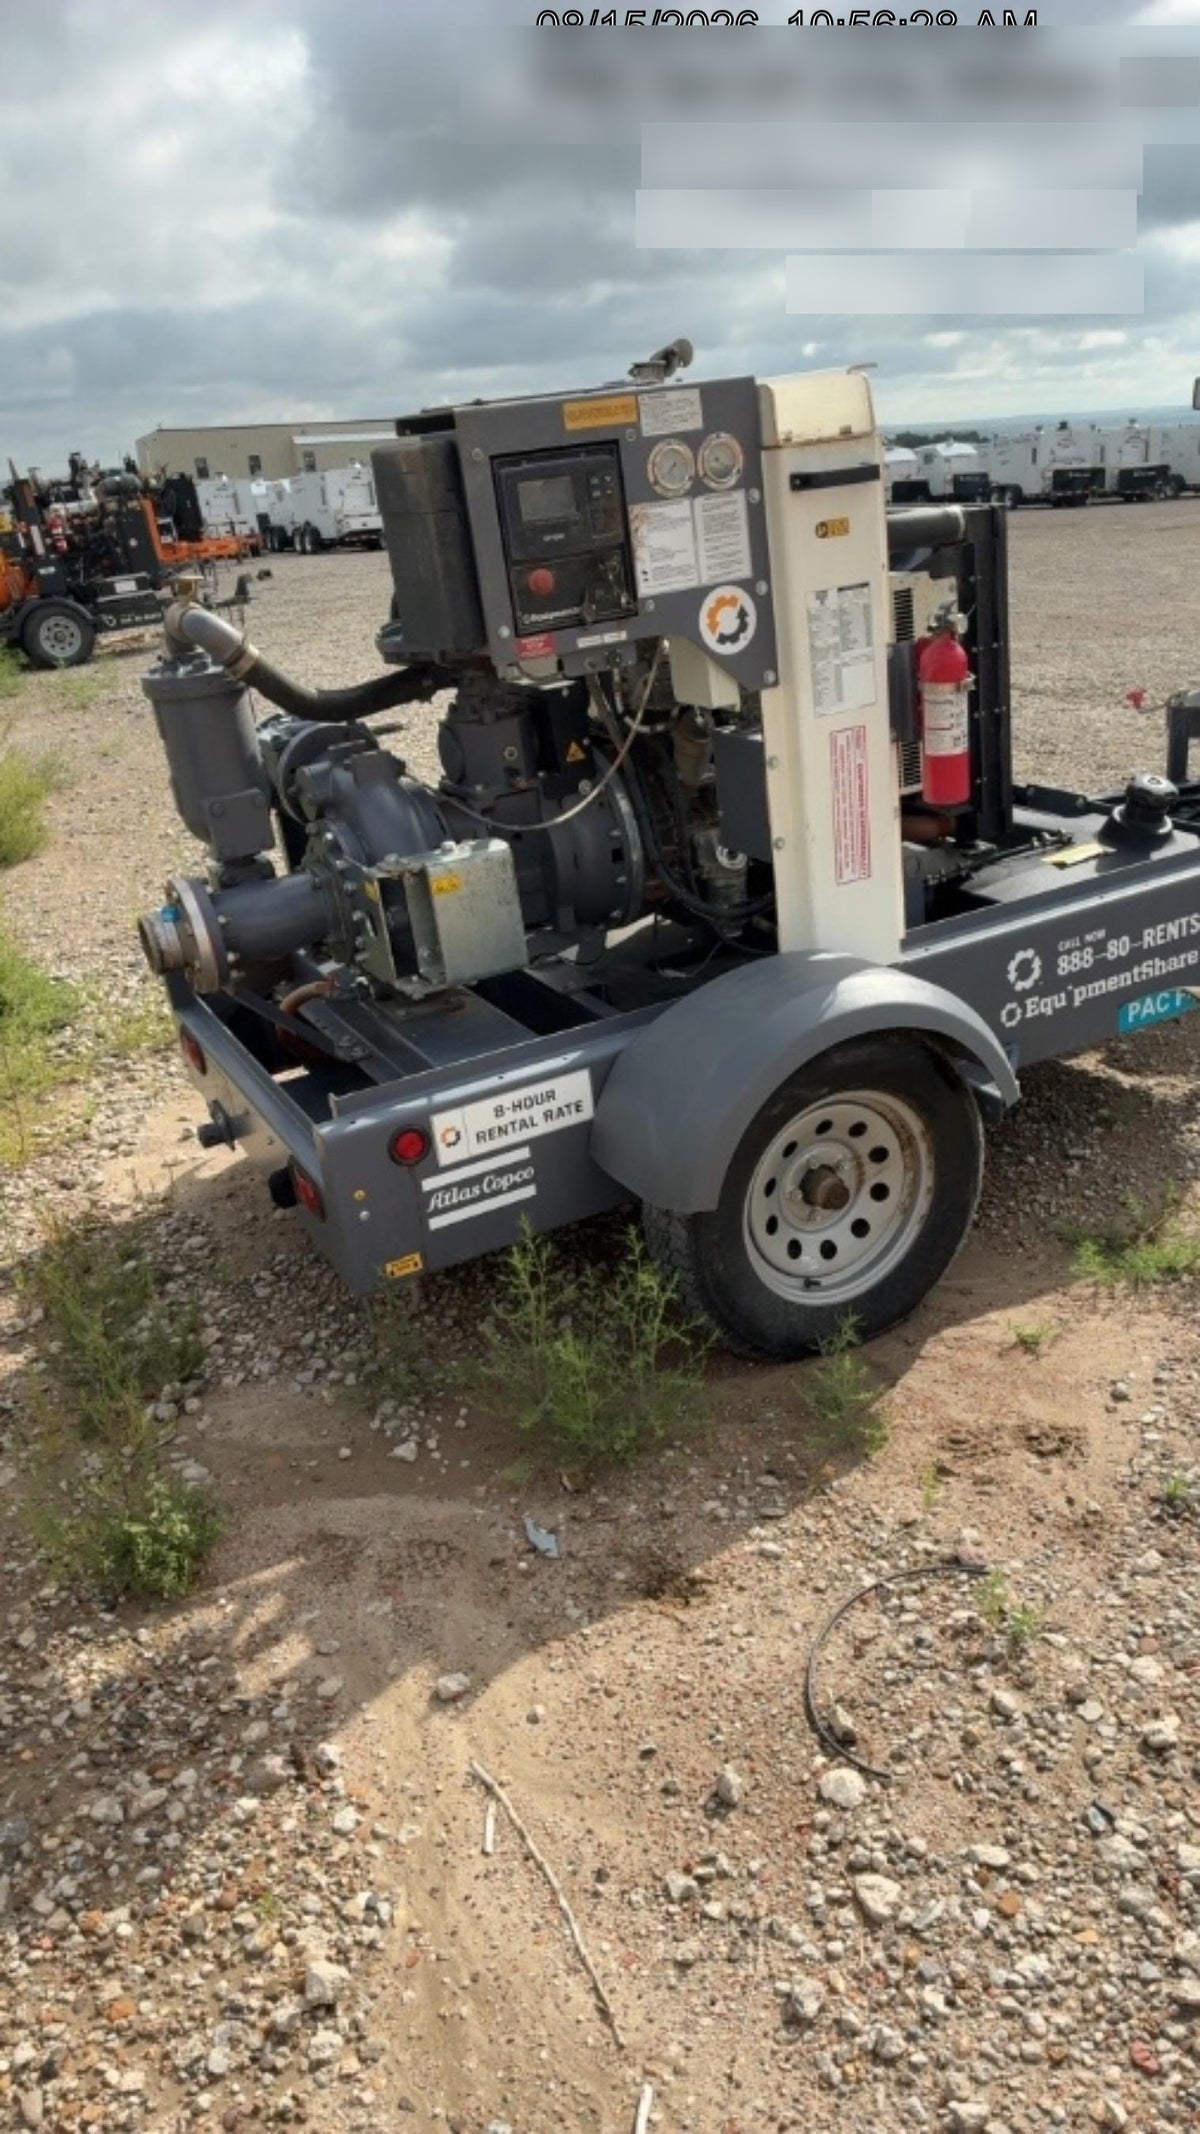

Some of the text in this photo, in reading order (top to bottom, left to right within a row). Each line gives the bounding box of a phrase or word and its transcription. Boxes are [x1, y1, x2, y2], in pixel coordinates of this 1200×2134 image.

[1057, 928, 1106, 952] CALL NOW
[1057, 912, 1200, 976] 888-80-RENTS
[1025, 949, 1199, 1017] EqupmentShare
[1128, 992, 1170, 1023] PAC
[475, 1100, 584, 1144] RENTAL RATE
[493, 1089, 556, 1118] 8-HOUR
[427, 1166, 534, 1212] Atlas Copco
